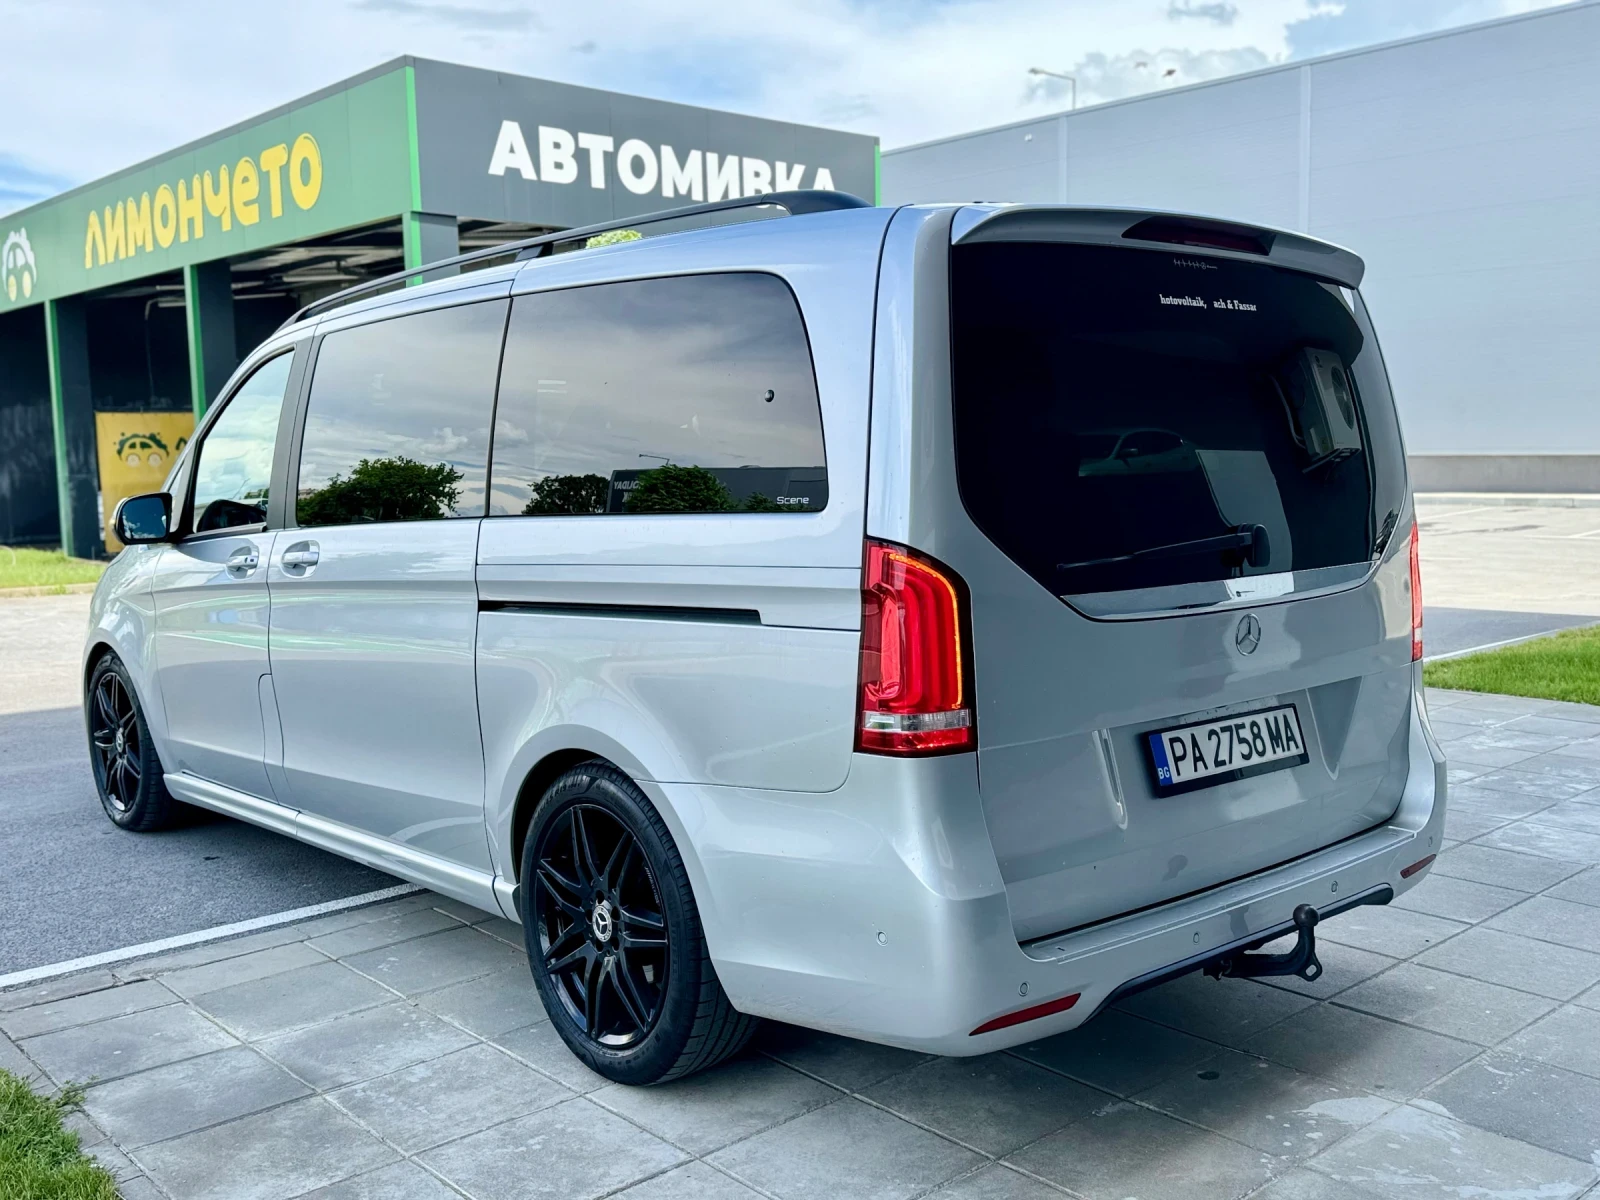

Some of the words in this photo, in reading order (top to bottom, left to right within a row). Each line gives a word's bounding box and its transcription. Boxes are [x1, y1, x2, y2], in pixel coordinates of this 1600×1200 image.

[776, 496, 810, 504] Scene
[1168, 733, 1209, 776] PA
[1207, 720, 1267, 768] 2758
[1265, 714, 1299, 754] MA
[1158, 767, 1170, 779] BG
